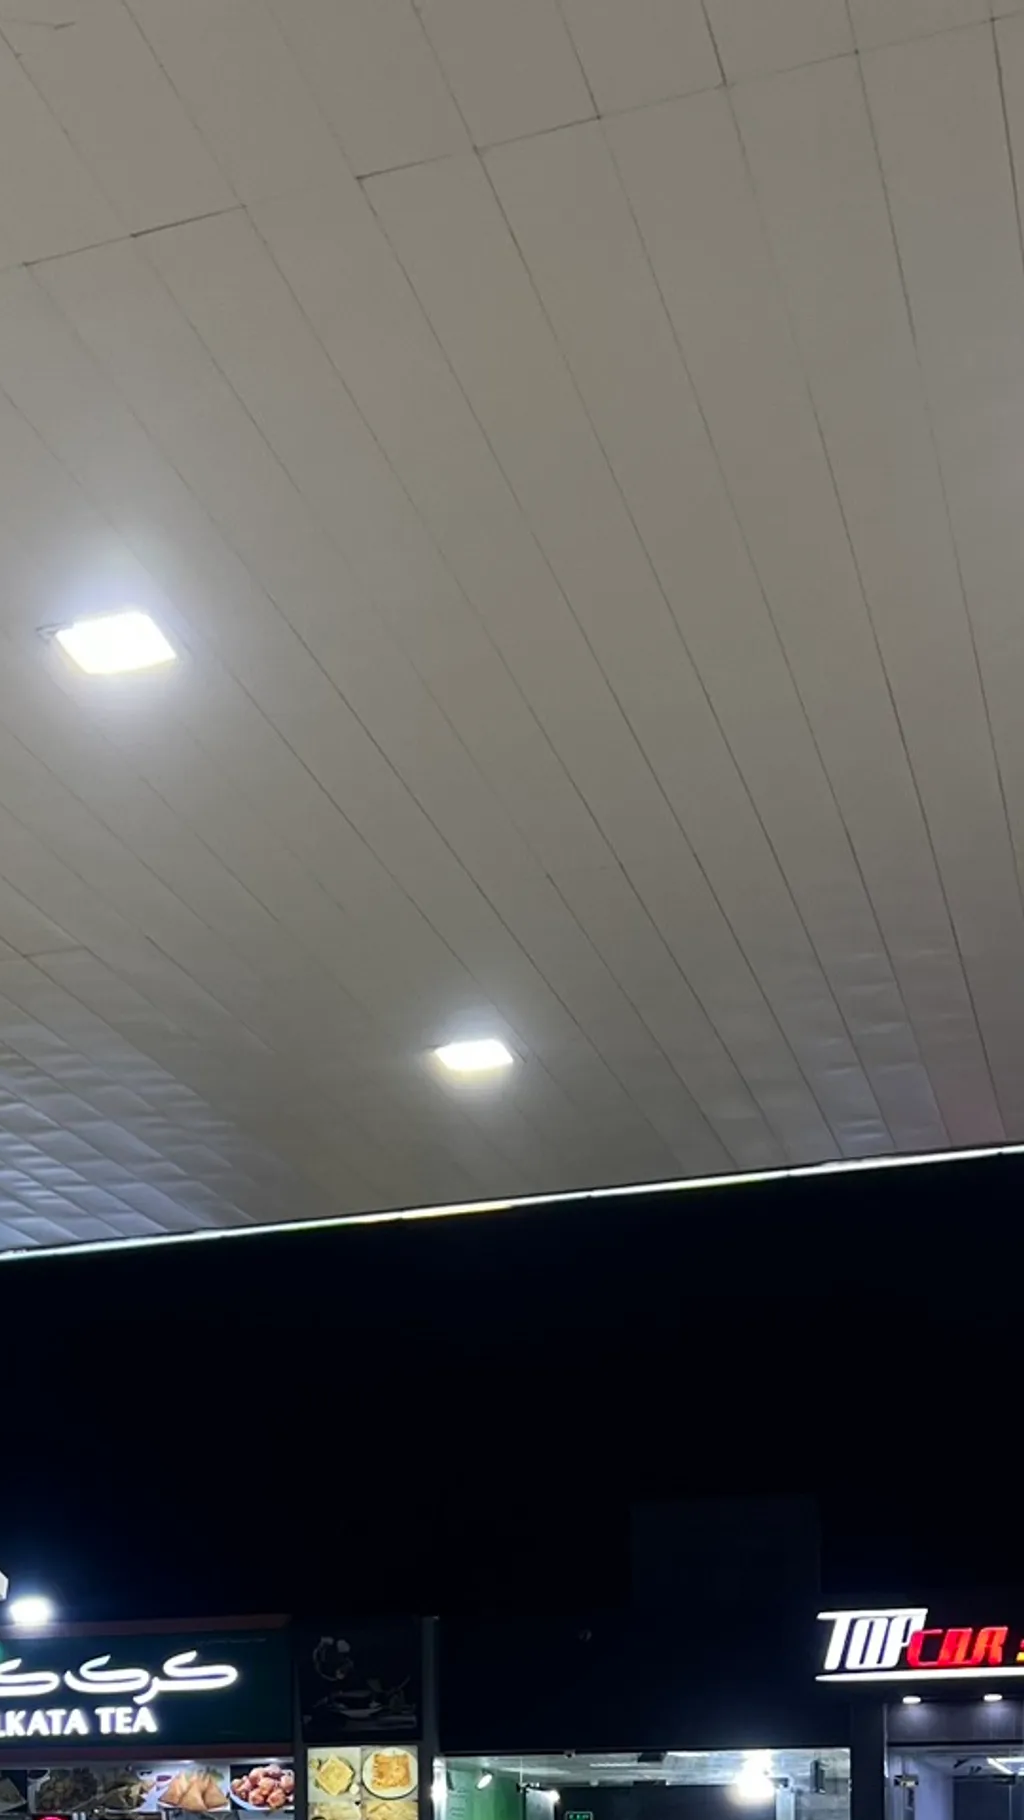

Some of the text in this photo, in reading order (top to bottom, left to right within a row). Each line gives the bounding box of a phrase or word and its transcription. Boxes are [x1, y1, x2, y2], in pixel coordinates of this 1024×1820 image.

[816, 1608, 928, 1670] TOP
[64, 1650, 239, 1704] كرك
[95, 1706, 158, 1734] TEA
